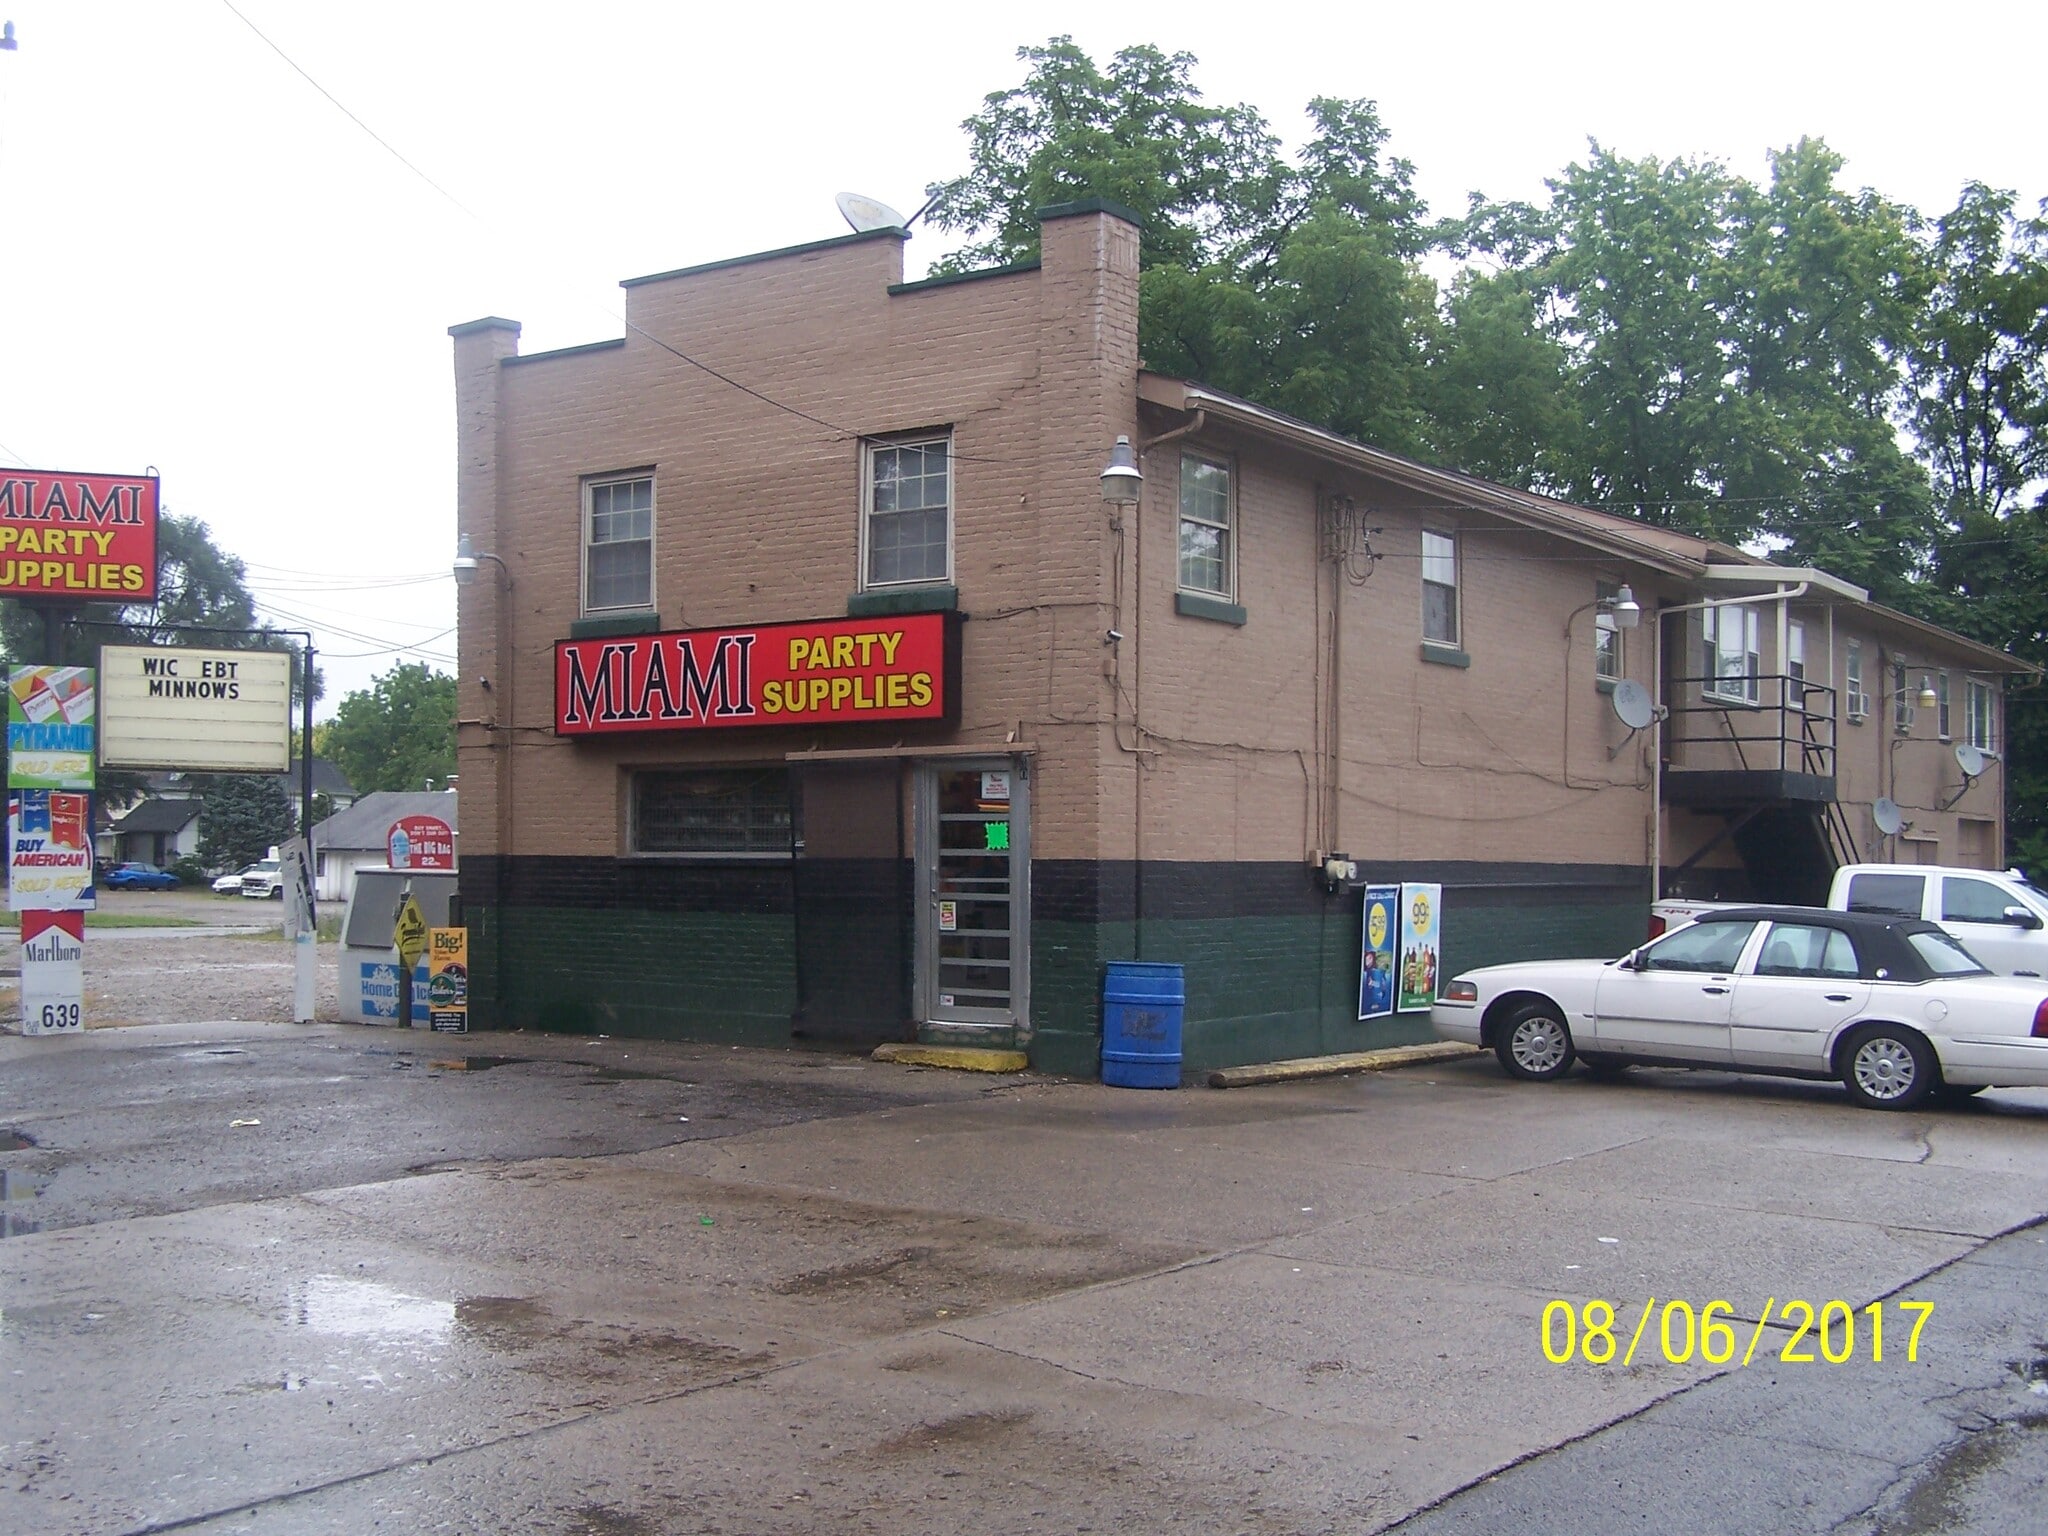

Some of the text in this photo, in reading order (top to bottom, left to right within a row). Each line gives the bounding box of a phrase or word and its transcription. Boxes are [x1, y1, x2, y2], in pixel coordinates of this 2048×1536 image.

[0, 526, 116, 557] PARTY
[0, 559, 145, 592] UPPLIES
[789, 632, 904, 671] PARTY
[143, 658, 239, 679] WIC EBT
[565, 634, 755, 729] MIAMI
[149, 680, 239, 700] MINNOWS
[762, 672, 933, 714] SUPPLIES
[9, 722, 95, 751] PYRAMID
[16, 839, 45, 852] BUY
[13, 853, 84, 867] AMERICAN
[26, 935, 81, 963] Marlboro
[434, 931, 464, 954] Big!
[361, 980, 393, 996] Home
[42, 1003, 80, 1028] 639
